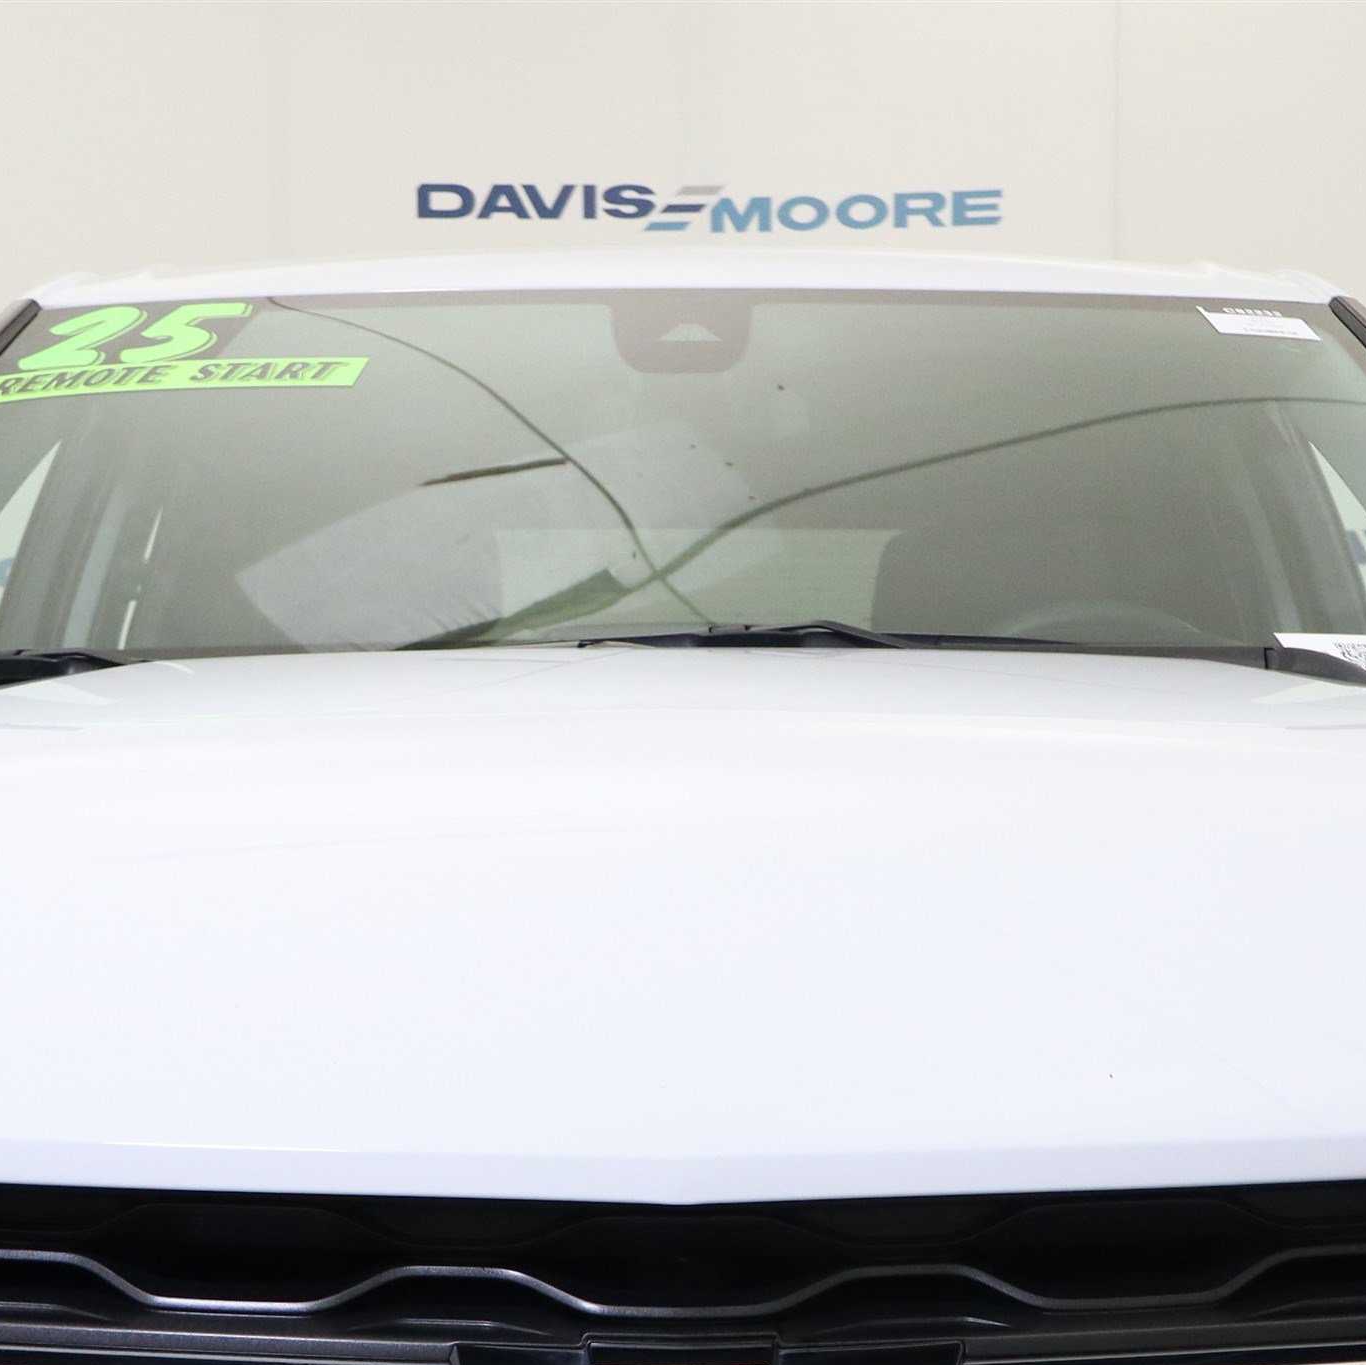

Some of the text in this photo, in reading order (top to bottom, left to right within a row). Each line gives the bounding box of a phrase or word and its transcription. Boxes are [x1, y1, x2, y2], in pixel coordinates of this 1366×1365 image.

[417, 183, 1003, 233] DAVIS MOORE
[18, 302, 254, 370] 25
[191, 360, 354, 383] START
